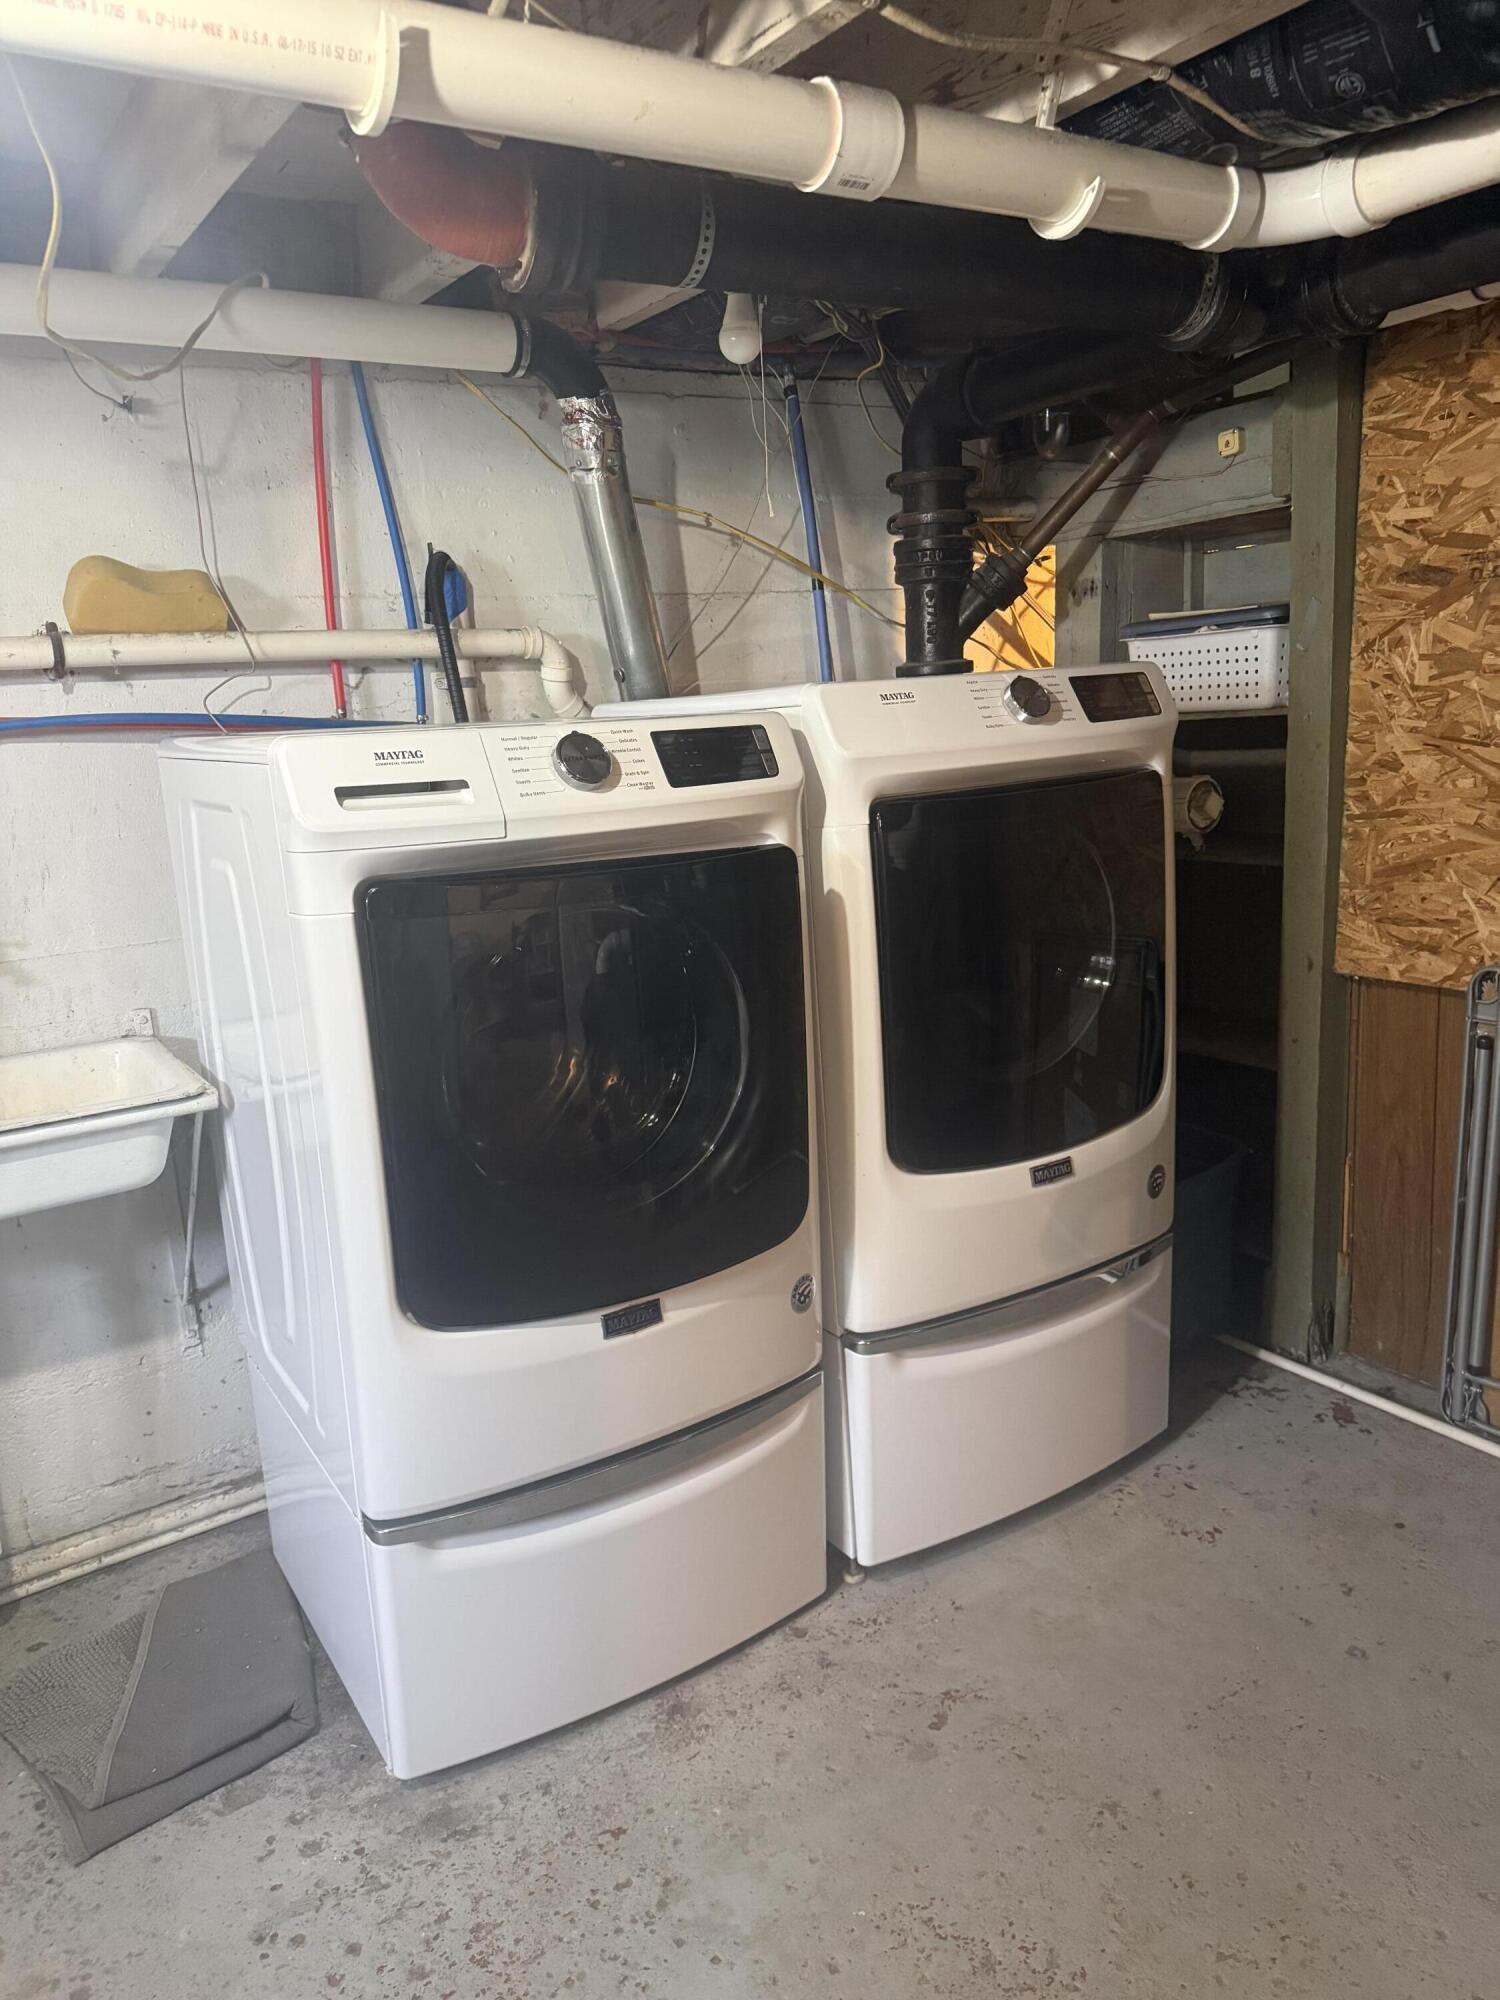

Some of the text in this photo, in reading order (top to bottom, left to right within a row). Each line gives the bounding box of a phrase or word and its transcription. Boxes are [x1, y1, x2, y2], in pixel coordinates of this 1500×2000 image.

[880, 691, 914, 701] MAYTAG
[373, 749, 424, 761] MAYTAG
[1034, 1162, 1071, 1183] MAYTAG
[607, 1307, 658, 1333] MAYTAG
